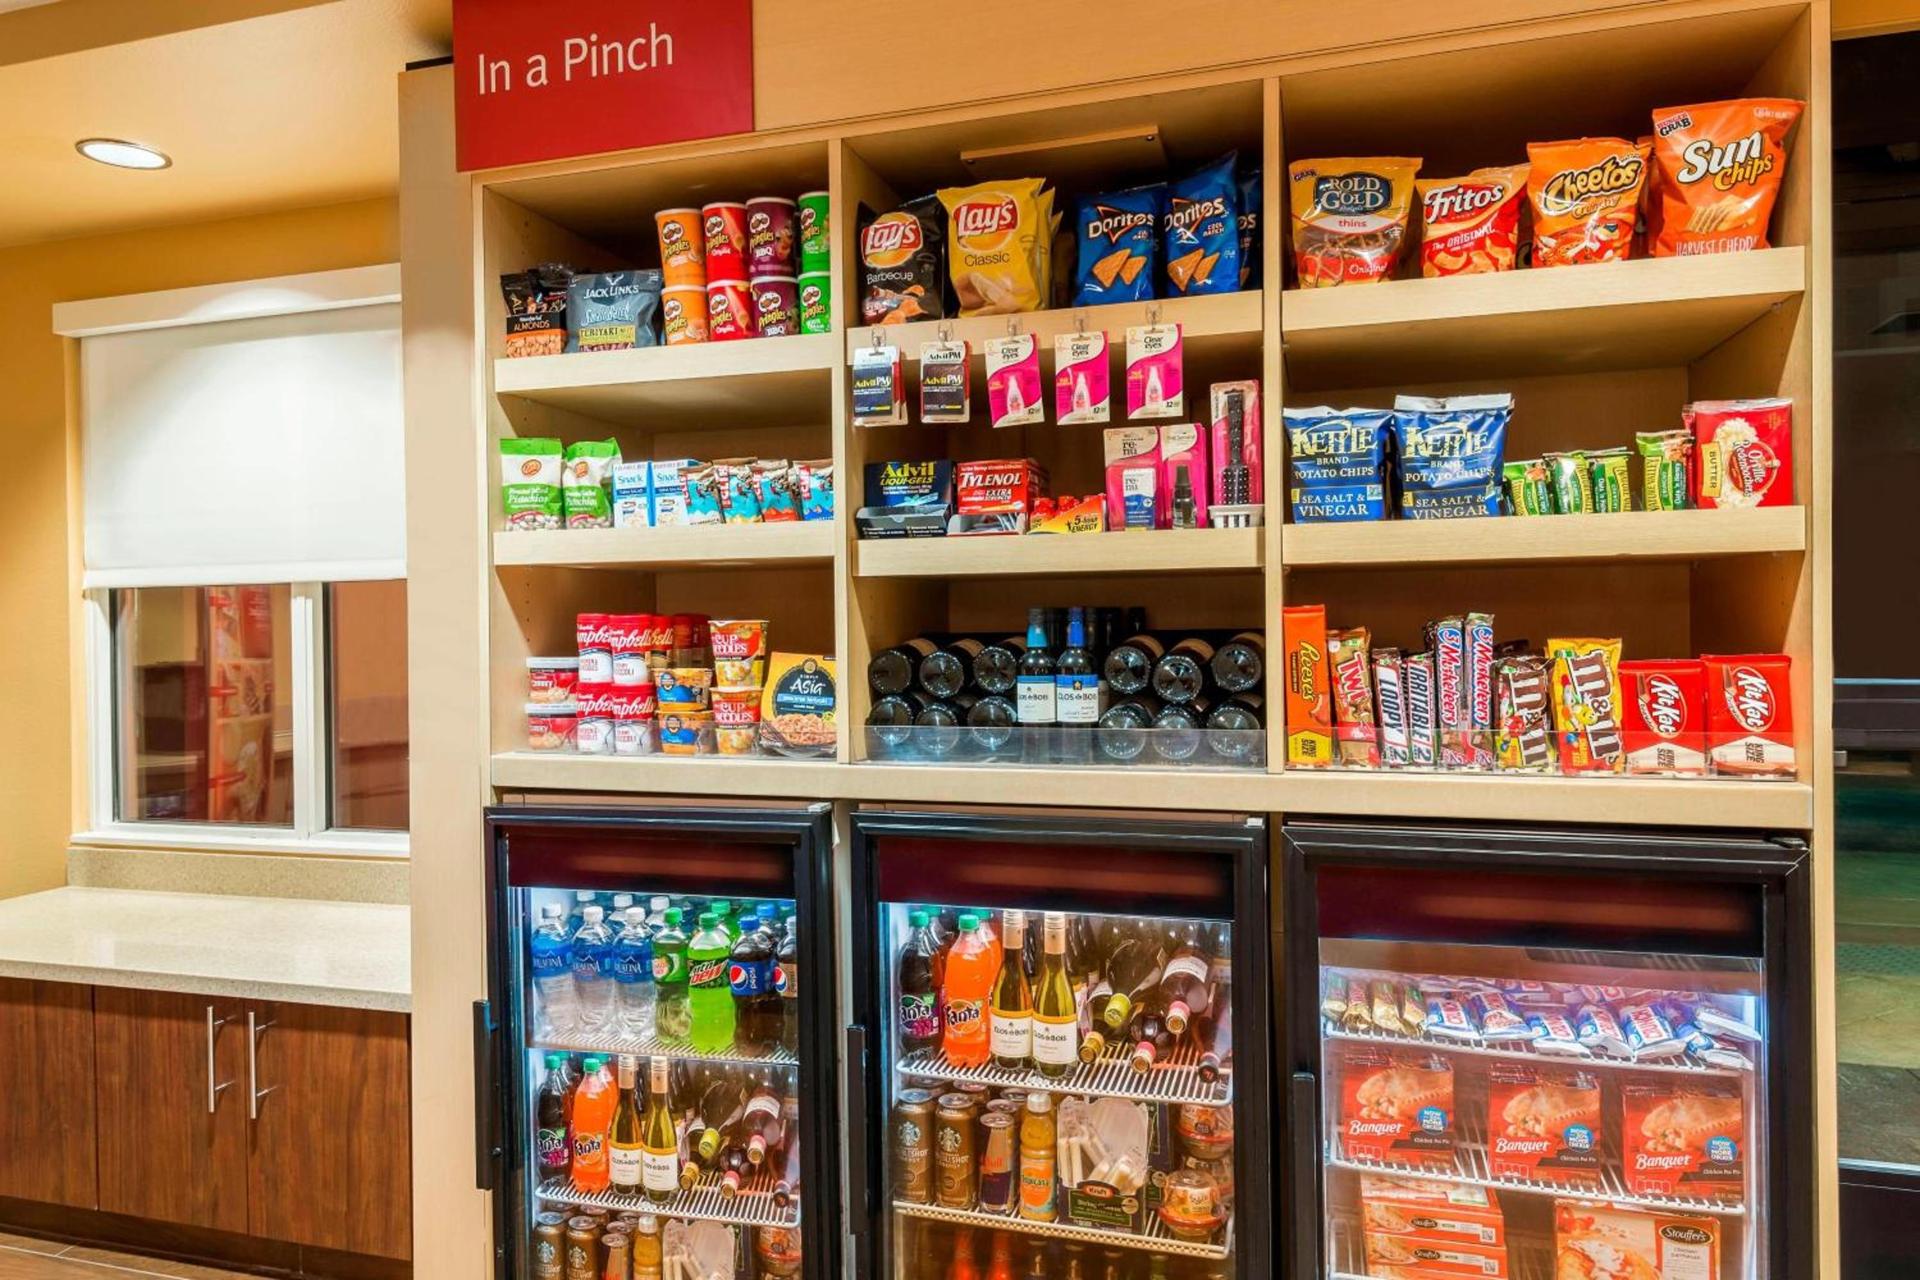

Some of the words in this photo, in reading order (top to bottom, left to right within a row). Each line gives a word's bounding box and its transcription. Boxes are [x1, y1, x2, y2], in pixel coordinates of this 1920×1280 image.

[478, 54, 511, 95] In
[526, 53, 549, 88] a
[564, 22, 674, 82] Pinch
[1659, 118, 1691, 136] GRAB
[1677, 131, 1761, 184] Sun
[1713, 153, 1773, 191] Chips
[1542, 156, 1643, 216] Cheetos
[1320, 191, 1384, 210] GOLD
[1424, 184, 1504, 225] Fritos
[958, 198, 1014, 237] Lay's
[1338, 219, 1367, 228] thins
[1088, 212, 1154, 240] Doritos
[865, 221, 916, 253] Lay's
[964, 251, 1010, 267] Classic
[866, 271, 914, 285] Barbecue
[584, 288, 608, 299] JACK
[514, 320, 550, 332] ALMONDS
[759, 308, 788, 329] Pringles
[580, 326, 618, 338] TERIYAKI
[1144, 336, 1164, 344] Clear
[1071, 343, 1090, 352] Clear
[1072, 349, 1089, 357] eyes
[1145, 342, 1162, 350] eyes
[949, 350, 961, 359] PM
[855, 377, 877, 389] Advil
[876, 375, 891, 386] PM
[924, 374, 948, 386] Advil
[1291, 420, 1378, 458] KETTLE
[1405, 422, 1496, 458] KETTLE
[1316, 456, 1350, 466] BRAND
[1430, 459, 1466, 469] BRAND
[1748, 449, 1767, 485] Orville
[881, 462, 936, 478] Advil
[1295, 468, 1338, 480] POTATO
[1339, 466, 1375, 477] CHIPS
[1405, 470, 1453, 482] POTATO
[1709, 451, 1717, 489] BUTTER
[880, 477, 933, 486] LIQUI-GELS
[960, 472, 1022, 489] TYLENOL
[1301, 493, 1323, 504] SEA
[1325, 492, 1353, 504] SALT
[1356, 493, 1367, 502] &
[1416, 498, 1438, 509] SEA
[1441, 496, 1473, 506] SALT
[1475, 495, 1486, 504] &
[1299, 503, 1370, 517] VINEGAR
[1412, 504, 1490, 520] VINEGAR
[714, 634, 739, 646] CUP
[1443, 628, 1460, 645] 3
[1476, 625, 1493, 644] 3
[1299, 641, 1321, 703] Reese's
[789, 679, 826, 695] Asia
[1439, 643, 1462, 726] Musketeers
[1473, 643, 1495, 727] Musketeers
[720, 703, 746, 714] CUP
[1379, 679, 1404, 735] LOOPY
[1409, 664, 1431, 740] IRRITABLE
[1300, 738, 1309, 756] SIZE
[1308, 739, 1317, 758] KING
[1394, 748, 1407, 762] 2
[1418, 747, 1432, 762] 2
[1744, 741, 1755, 763] SIZE
[1754, 743, 1765, 763] KING
[1656, 747, 1667, 767] SIZE
[1665, 748, 1676, 770] KING
[749, 966, 757, 990] pepsi
[944, 1004, 980, 1027] Fanta
[1348, 1120, 1404, 1136] Banquet
[575, 1138, 601, 1157] Fanta
[1496, 1137, 1552, 1153] Banquet
[1635, 1153, 1692, 1169] Banquet
[1665, 1227, 1707, 1243] Stouffer's
